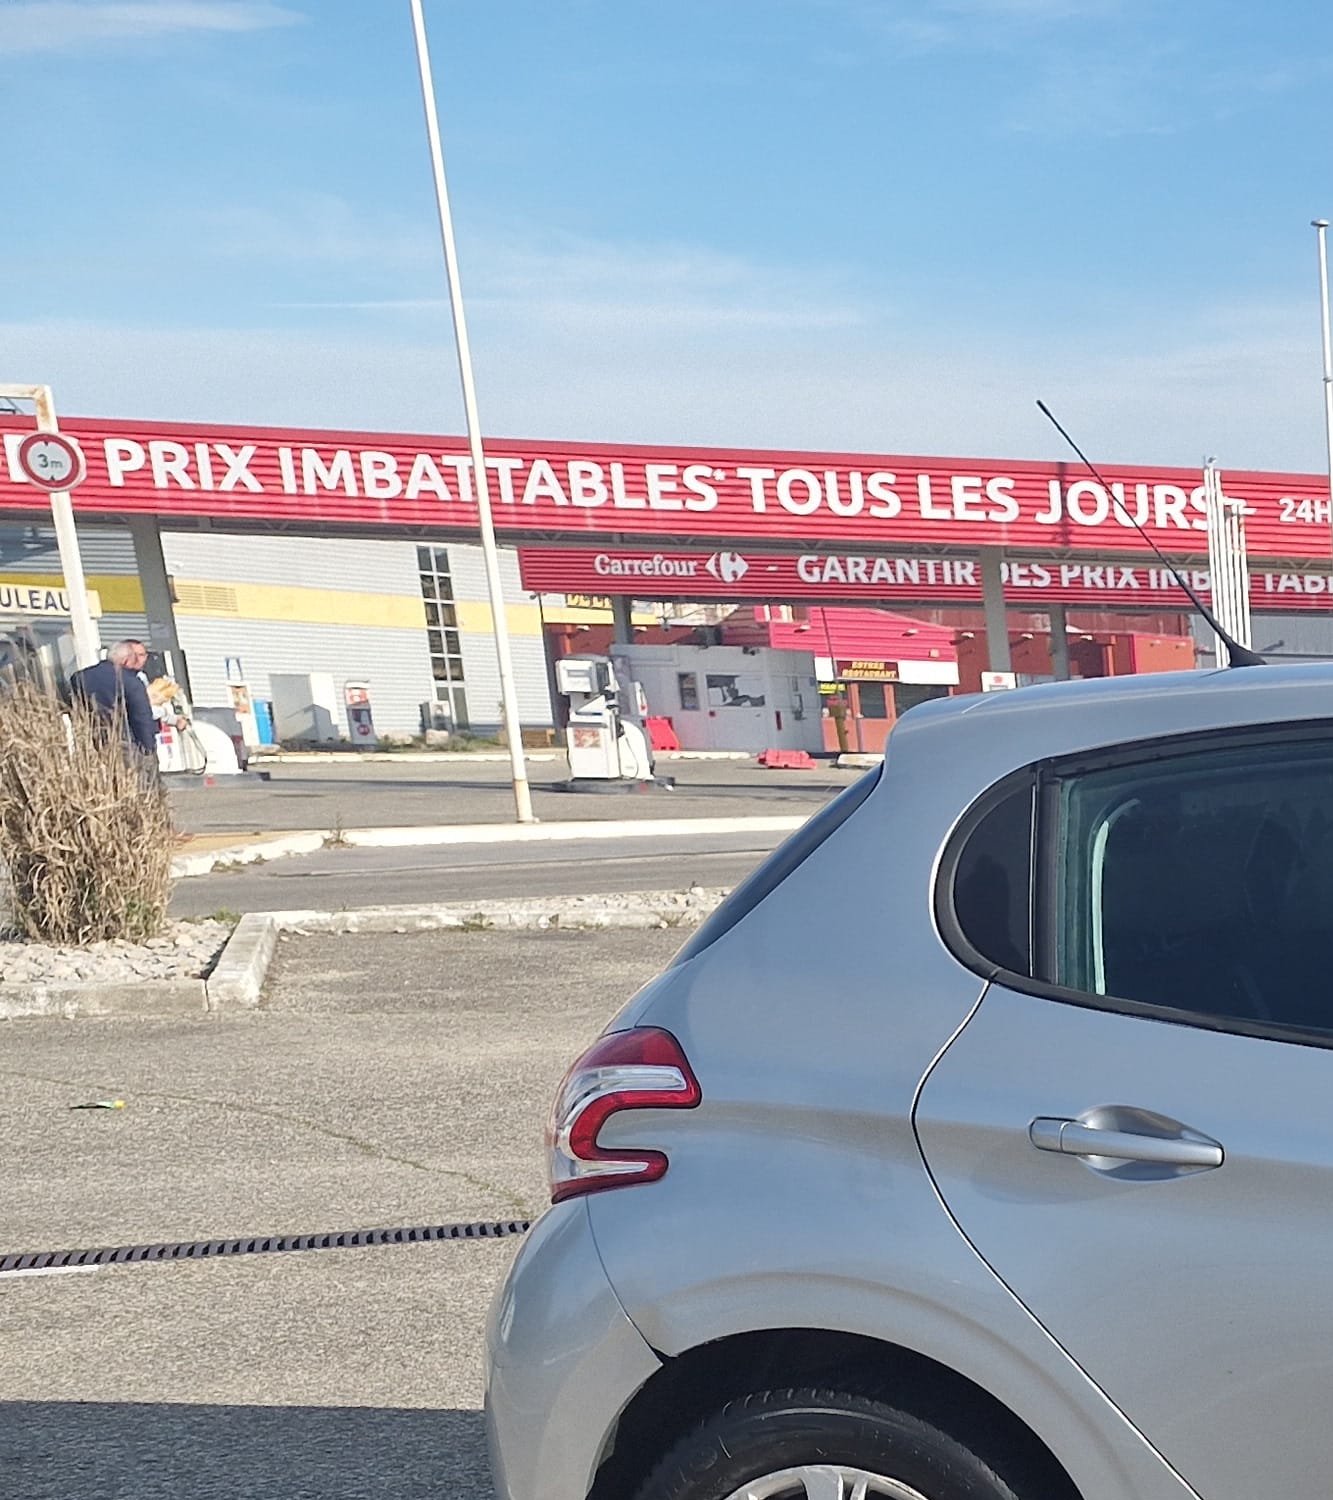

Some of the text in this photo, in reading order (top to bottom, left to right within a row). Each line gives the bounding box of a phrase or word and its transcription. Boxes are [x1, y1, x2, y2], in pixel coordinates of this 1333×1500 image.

[103, 438, 264, 493] PRIX
[737, 467, 902, 518] TOUS
[917, 474, 1020, 523] LES
[1035, 479, 1210, 530] JOURS
[594, 554, 698, 577] Carrefour
[797, 555, 976, 585] GARANTIR
[1000, 562, 1051, 588] ES
[1061, 565, 1141, 588] PRIX
